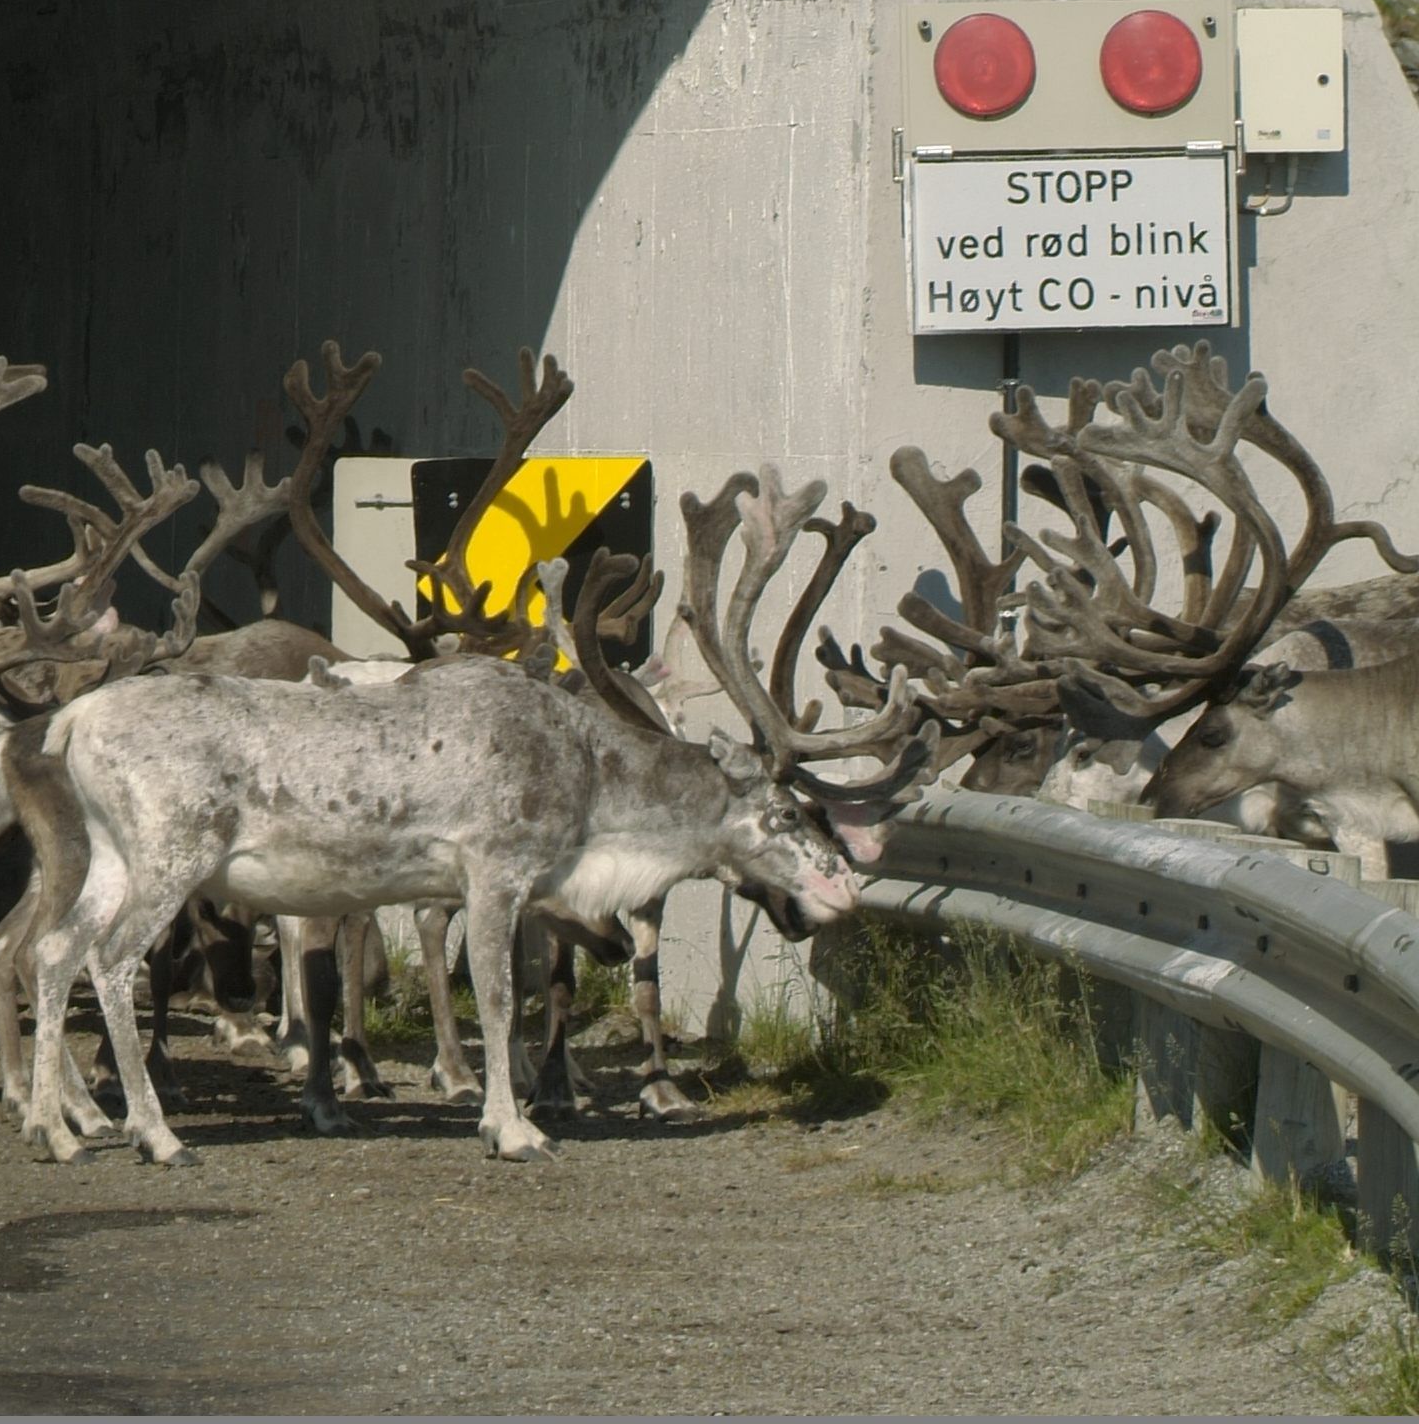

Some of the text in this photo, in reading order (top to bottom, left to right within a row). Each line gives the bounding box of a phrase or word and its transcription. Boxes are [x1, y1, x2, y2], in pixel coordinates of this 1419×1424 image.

[1007, 169, 1133, 205] STOPP
[936, 221, 1209, 260] ved rød blink
[928, 278, 1023, 322] Høyt
[1038, 278, 1095, 312] CO
[1136, 274, 1219, 309] nivå
